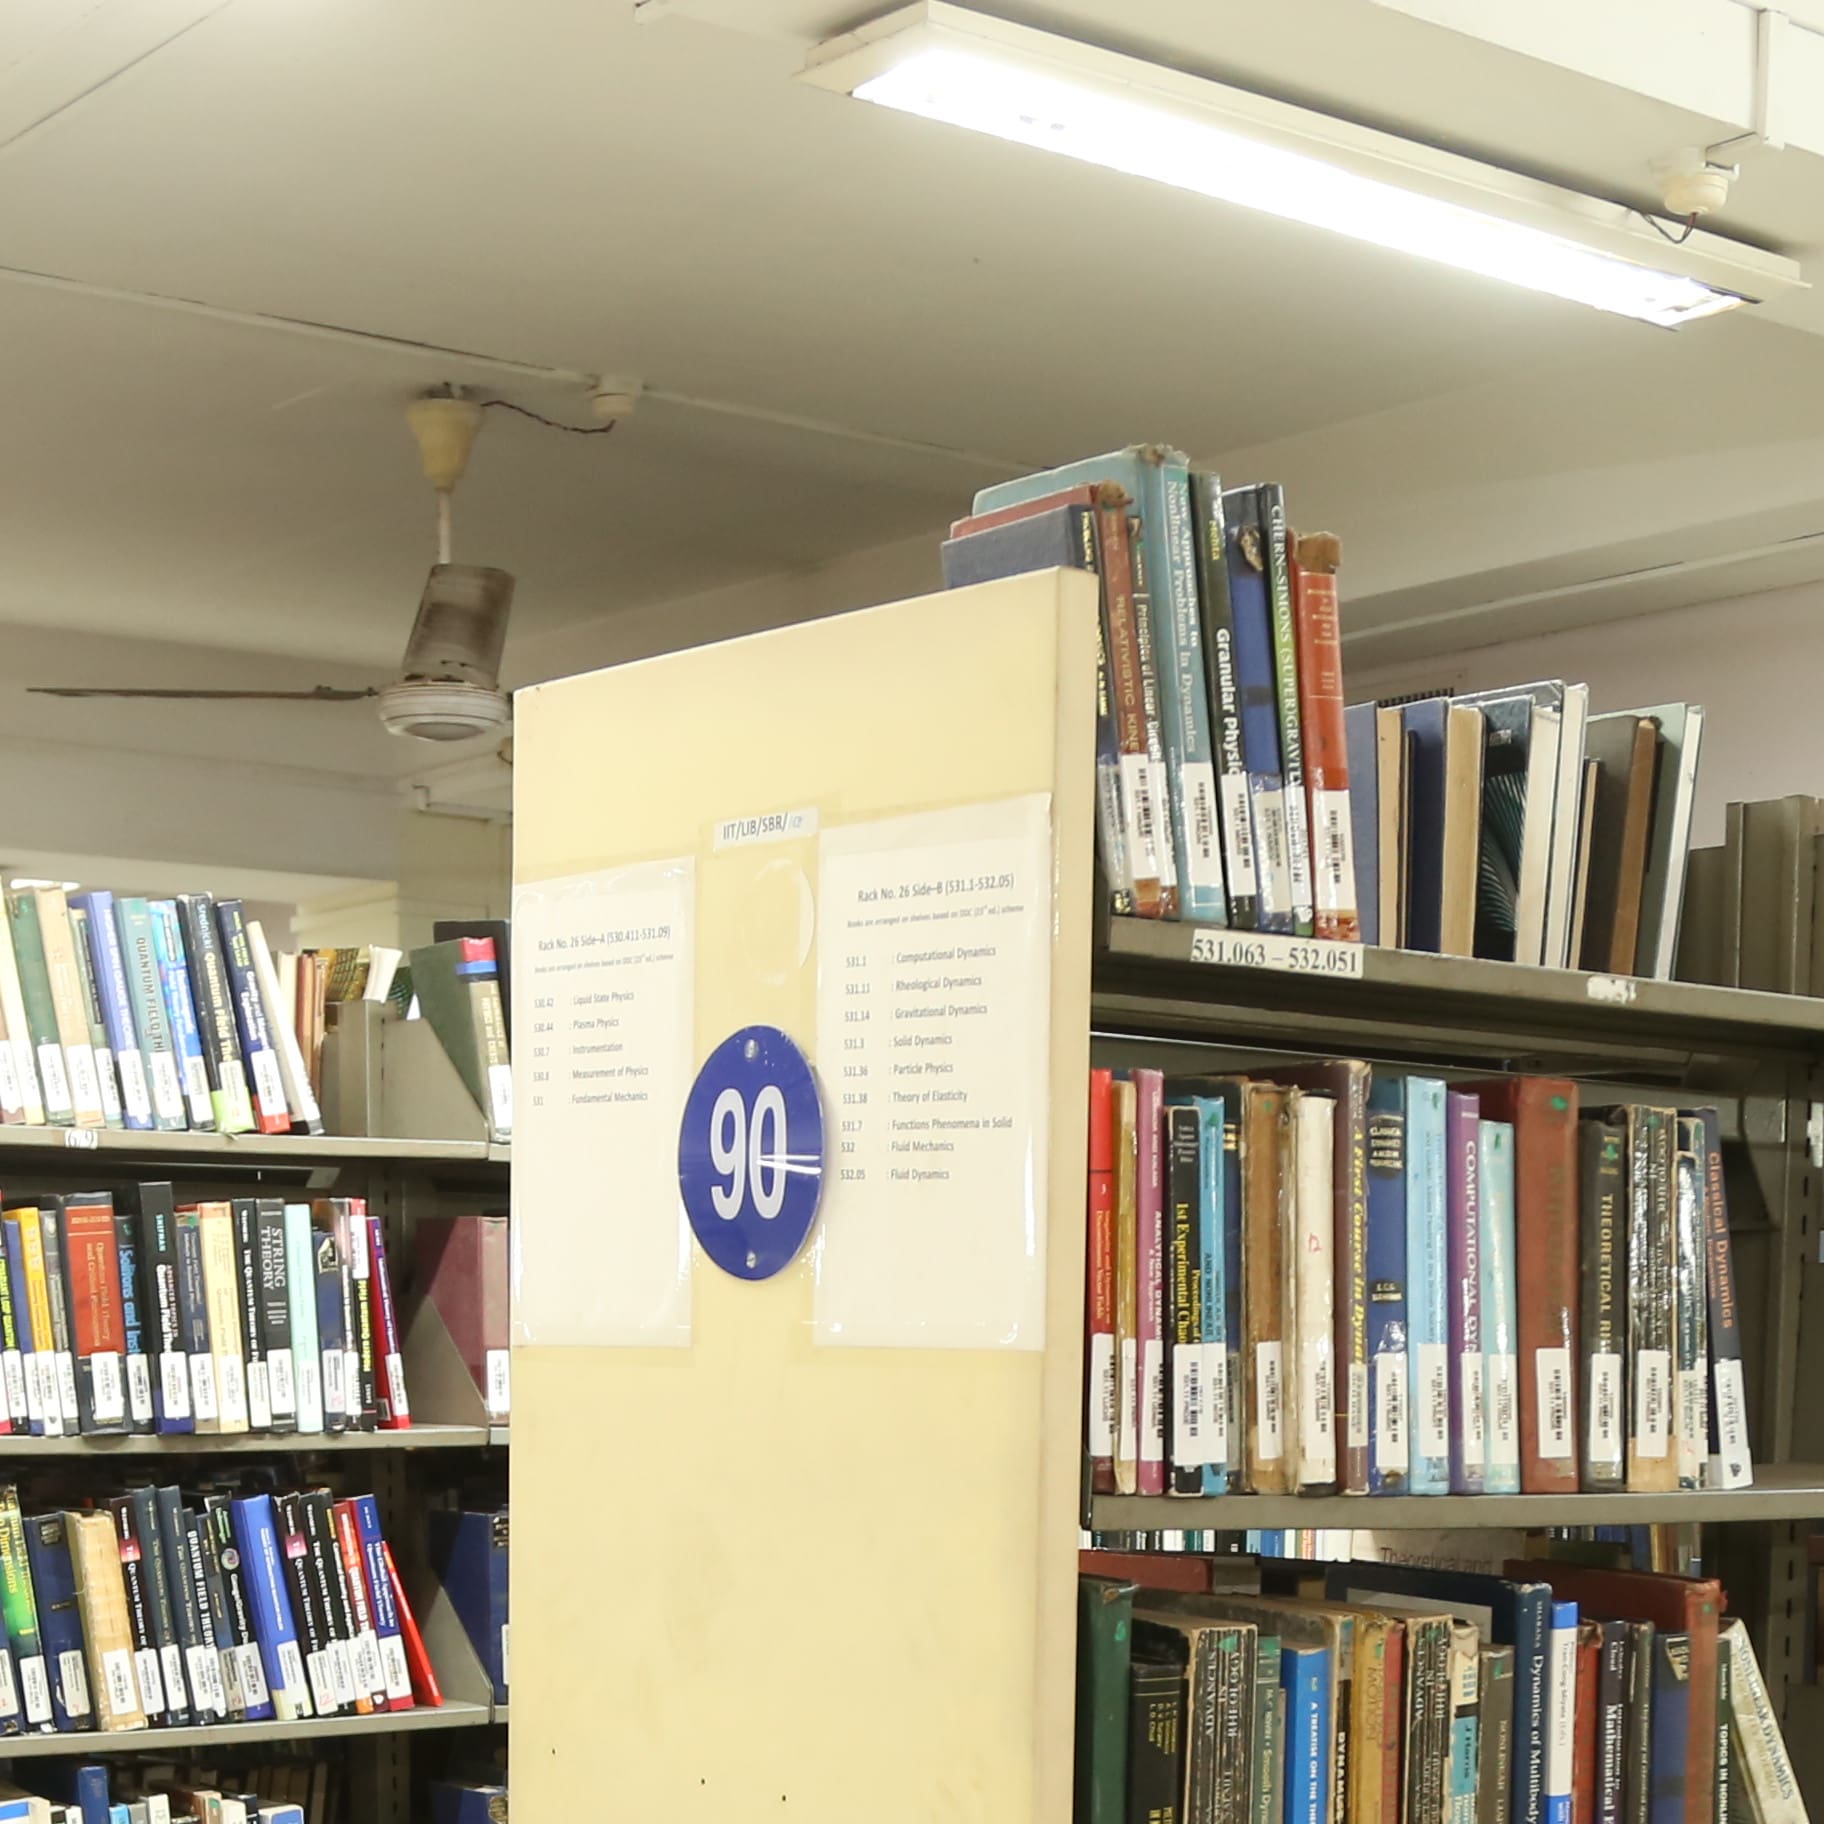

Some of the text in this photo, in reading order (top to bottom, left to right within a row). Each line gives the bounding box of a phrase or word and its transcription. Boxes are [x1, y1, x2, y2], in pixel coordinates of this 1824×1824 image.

[1208, 520, 1221, 561] Mehta
[1179, 482, 1200, 647] New Approaches to
[1137, 604, 1151, 662] Principles
[1167, 481, 1197, 752] Nonlinear Problems in Dynamics
[1115, 595, 1140, 751] RELATIVISTIC KINE
[1216, 628, 1246, 775] Granular Physic
[858, 889, 878, 902] Rack
[881, 888, 896, 900] No.
[899, 885, 909, 898] 26
[945, 873, 1014, 895] (531.1-532.05)
[196, 904, 212, 949] Srednicki
[538, 940, 554, 951] Rack
[556, 938, 567, 949] No.
[570, 936, 580, 947] 26
[846, 956, 866, 967] 531.1
[896, 945, 996, 965] Computational Dynamics
[1192, 939, 1266, 965] 531.063
[1289, 947, 1358, 973] 532.051
[135, 937, 165, 1052] QUANTUM FIELD TH
[573, 991, 634, 1006] Liquid State Physics
[846, 983, 870, 995] 531.11
[896, 976, 981, 992] Rheological Dynamics
[203, 952, 234, 1062] Quantum Field The
[573, 1017, 619, 1029] Plasma Physics
[845, 1011, 870, 1022] 531.14
[895, 1004, 987, 1020] Gravitational Dynamics
[573, 1043, 623, 1054] Instrumentation
[844, 1039, 864, 1050] 531.3
[893, 1035, 952, 1048] Solid Dynamics
[572, 1068, 615, 1079] Measurement
[626, 1065, 648, 1077] Physics
[894, 1063, 953, 1075] Particle Physics
[572, 1091, 648, 1104] Fundamental Mechanics
[893, 1092, 919, 1104] Theory
[932, 1090, 967, 1104] Elasticity
[842, 1121, 862, 1132] 531.7
[892, 1119, 929, 1130] Functions
[931, 1118, 979, 1128] Phenomena
[992, 1117, 1013, 1128] Solid
[710, 1084, 788, 1220] 90
[841, 1142, 855, 1153] 532
[891, 1141, 954, 1151] Fluid Mechanics
[840, 1169, 865, 1180] 532.05
[891, 1169, 949, 1182] Fluid Dynamics
[1351, 1126, 1365, 1364] A First Course in Dyna
[1464, 1141, 1479, 1353] COMPUTATIONAL DYN
[1600, 1194, 1614, 1312] THEORETICAL
[1708, 1152, 1735, 1328] Classical Dynamics
[261, 1226, 274, 1290] THEORY
[271, 1227, 285, 1288] STRING
[1175, 1203, 1189, 1343] 1st Experimental Chao
[120, 1250, 141, 1353] Solitons and Inst
[2, 1528, 19, 1593] Dimensions
[187, 1531, 204, 1578] QUANTUM
[196, 1581, 209, 1610] FIELD
[1530, 1655, 1544, 1726] Dynamics
[1530, 1731, 1542, 1745] of
[1719, 1724, 1729, 1763] TOPICS
[1602, 1705, 1618, 1811] Mathematical
[1719, 1769, 1728, 1780] IN
[1762, 1725, 1795, 1800] DYNAMICS
[1526, 1750, 1541, 1823] Multibody
